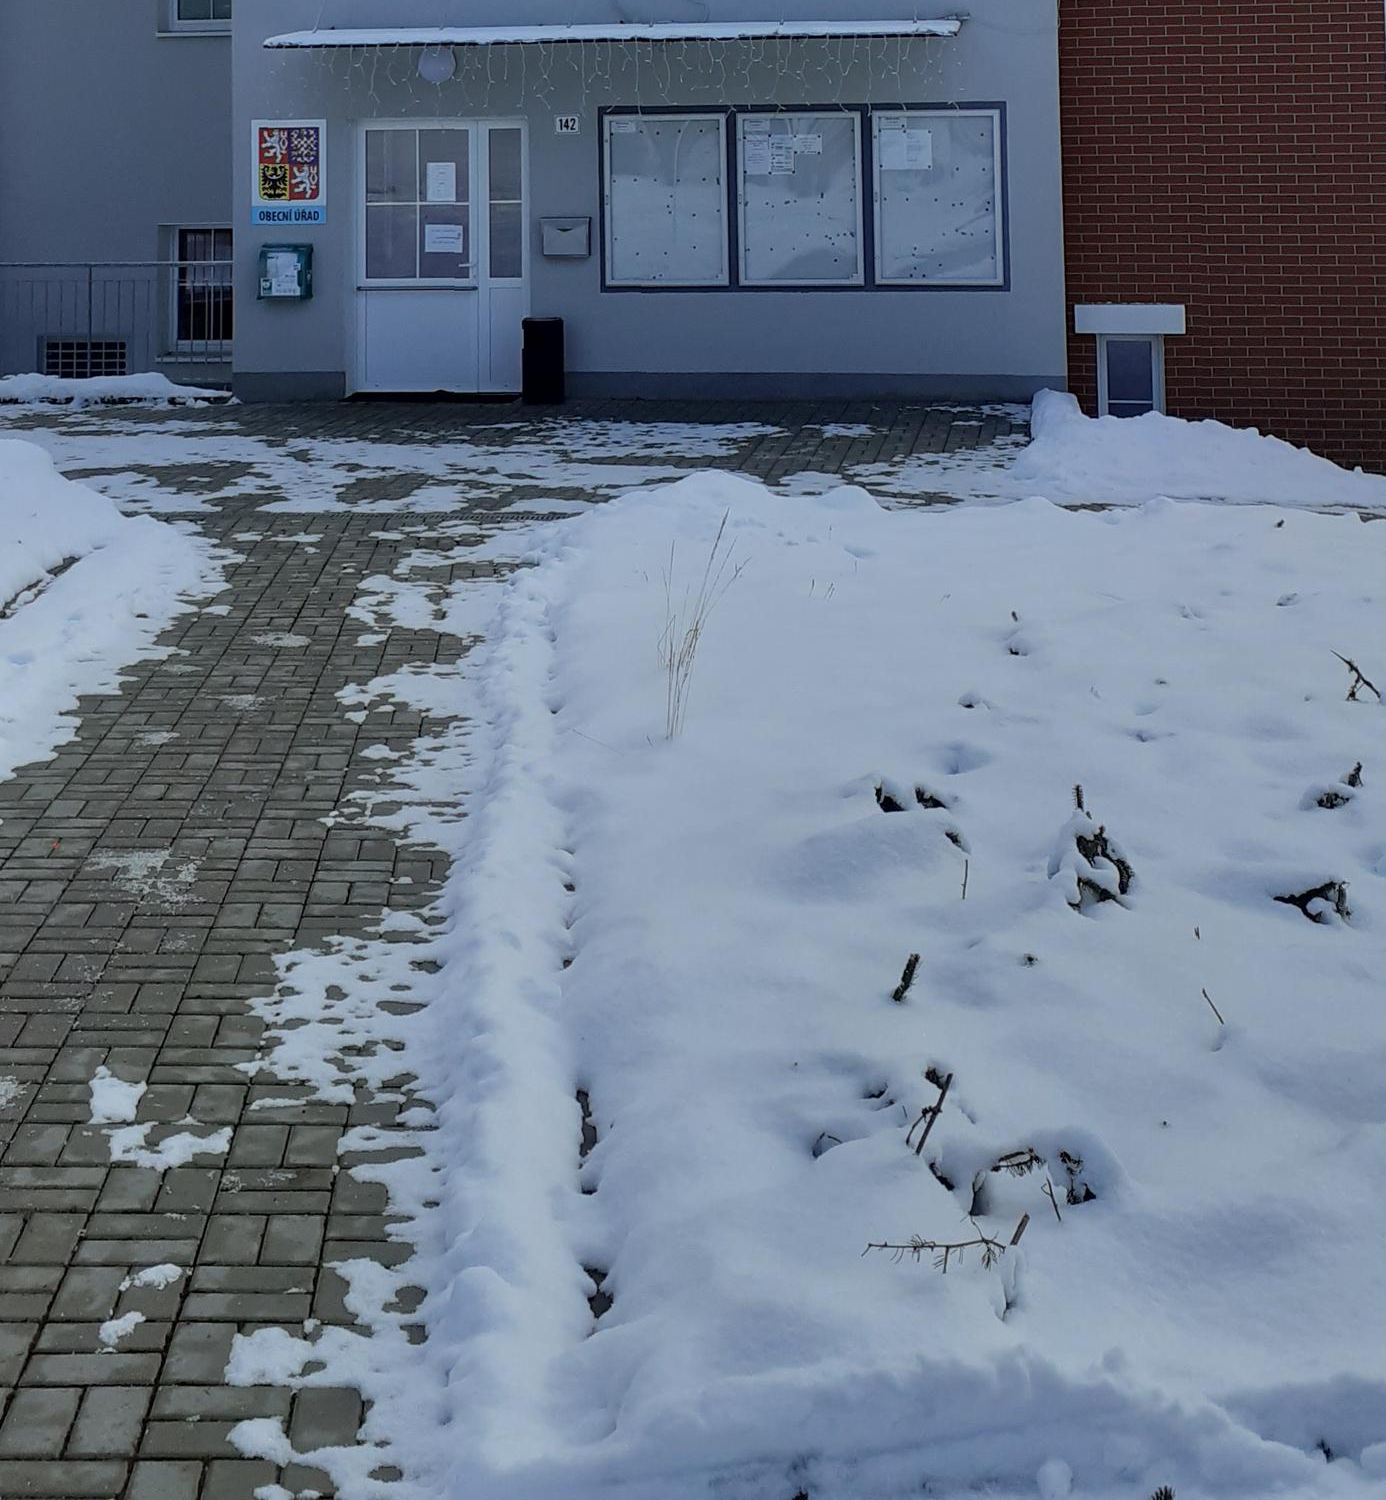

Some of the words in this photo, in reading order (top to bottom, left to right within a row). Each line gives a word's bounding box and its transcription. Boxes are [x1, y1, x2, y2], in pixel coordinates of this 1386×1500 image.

[558, 118, 576, 131] 142
[259, 209, 292, 221] OBECNÍ
[294, 208, 319, 221] ÚŘAD
